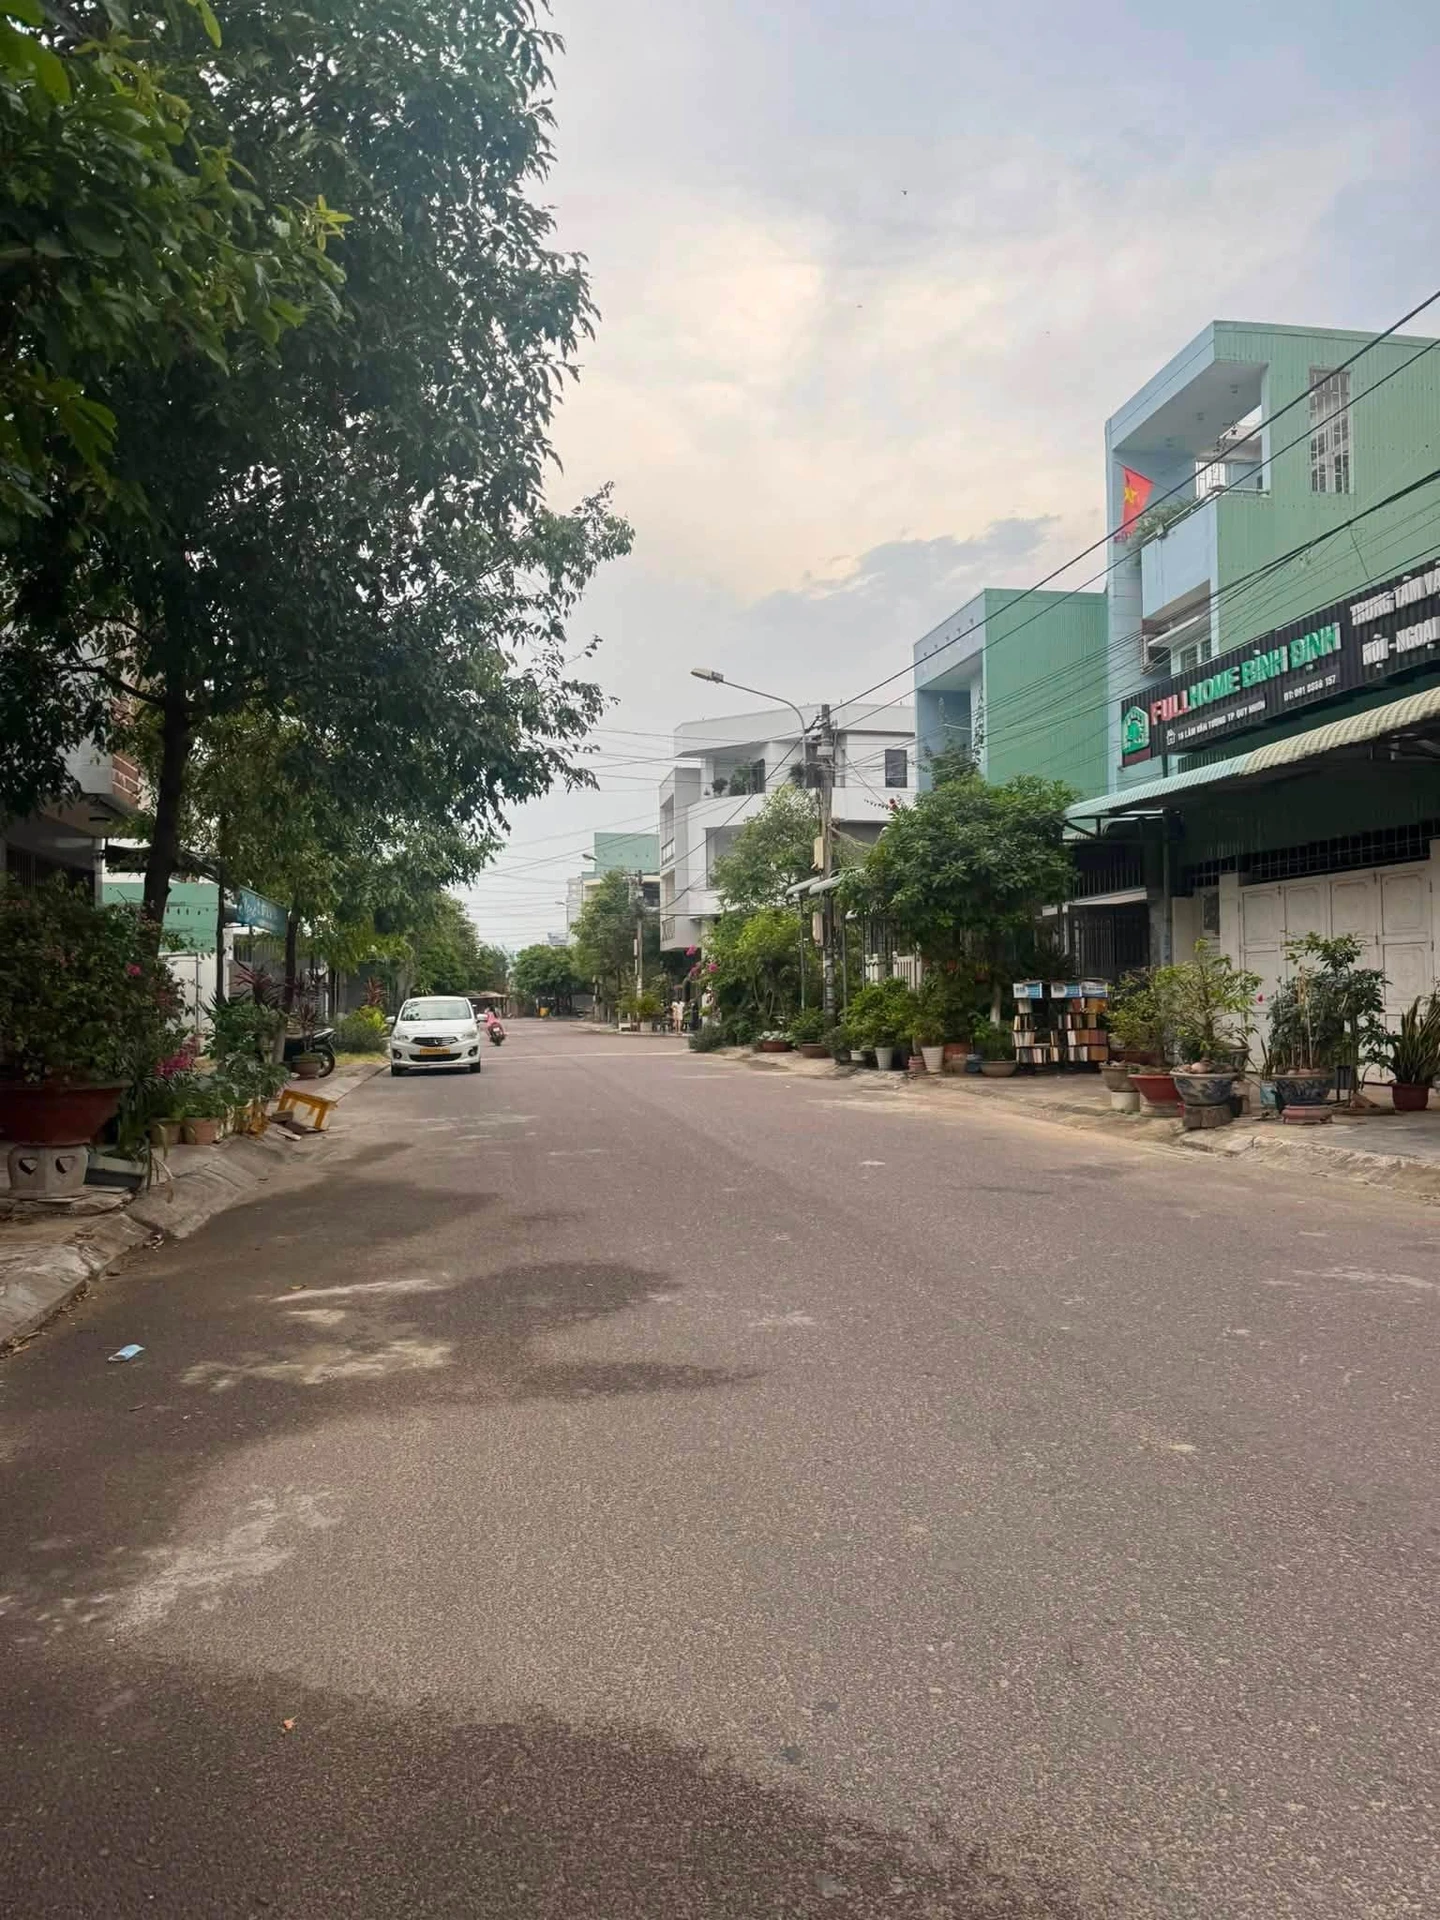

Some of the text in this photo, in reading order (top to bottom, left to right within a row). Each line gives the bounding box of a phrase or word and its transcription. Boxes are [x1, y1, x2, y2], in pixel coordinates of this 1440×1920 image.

[1350, 591, 1395, 627] TRUNG
[1395, 575, 1427, 609] TÂM
[1362, 633, 1390, 669] NỘI
[1151, 666, 1241, 726] FULLHOME
[1240, 649, 1289, 689] BÌNH
